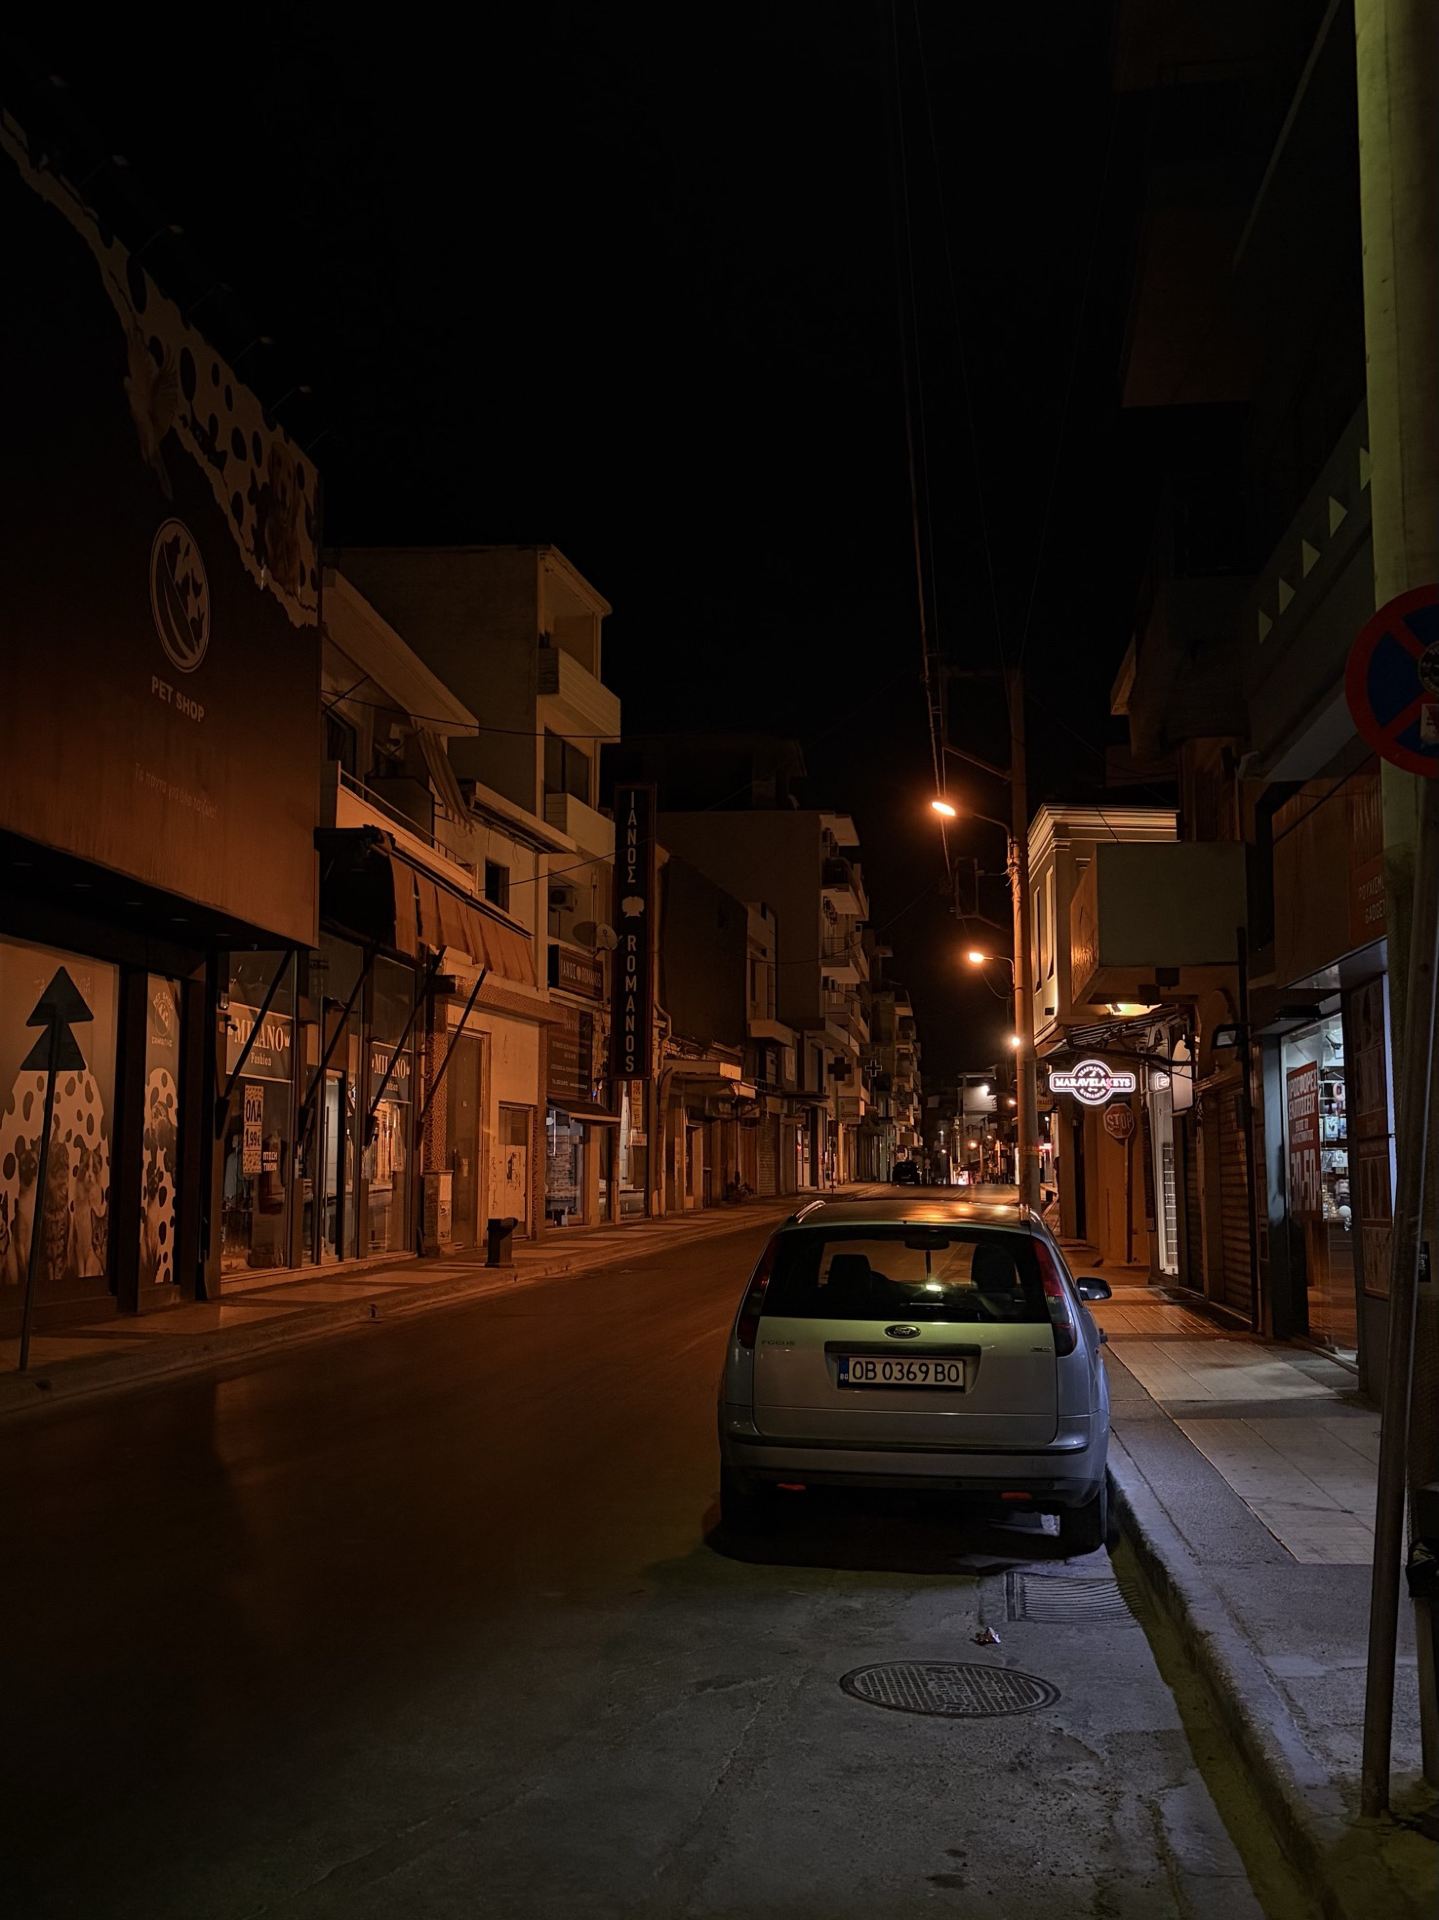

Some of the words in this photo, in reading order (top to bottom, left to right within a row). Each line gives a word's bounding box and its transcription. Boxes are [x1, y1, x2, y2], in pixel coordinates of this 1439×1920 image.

[151, 674, 174, 704] PET
[175, 692, 205, 723] SHOP
[627, 791, 638, 883] ΙΑΝΟΣ
[624, 934, 638, 1073] ROMANOS
[1055, 1078, 1131, 1089] MARAVELAKEYS
[246, 1099, 262, 1122] ΟΛΑ
[1106, 1112, 1133, 1129] STOP
